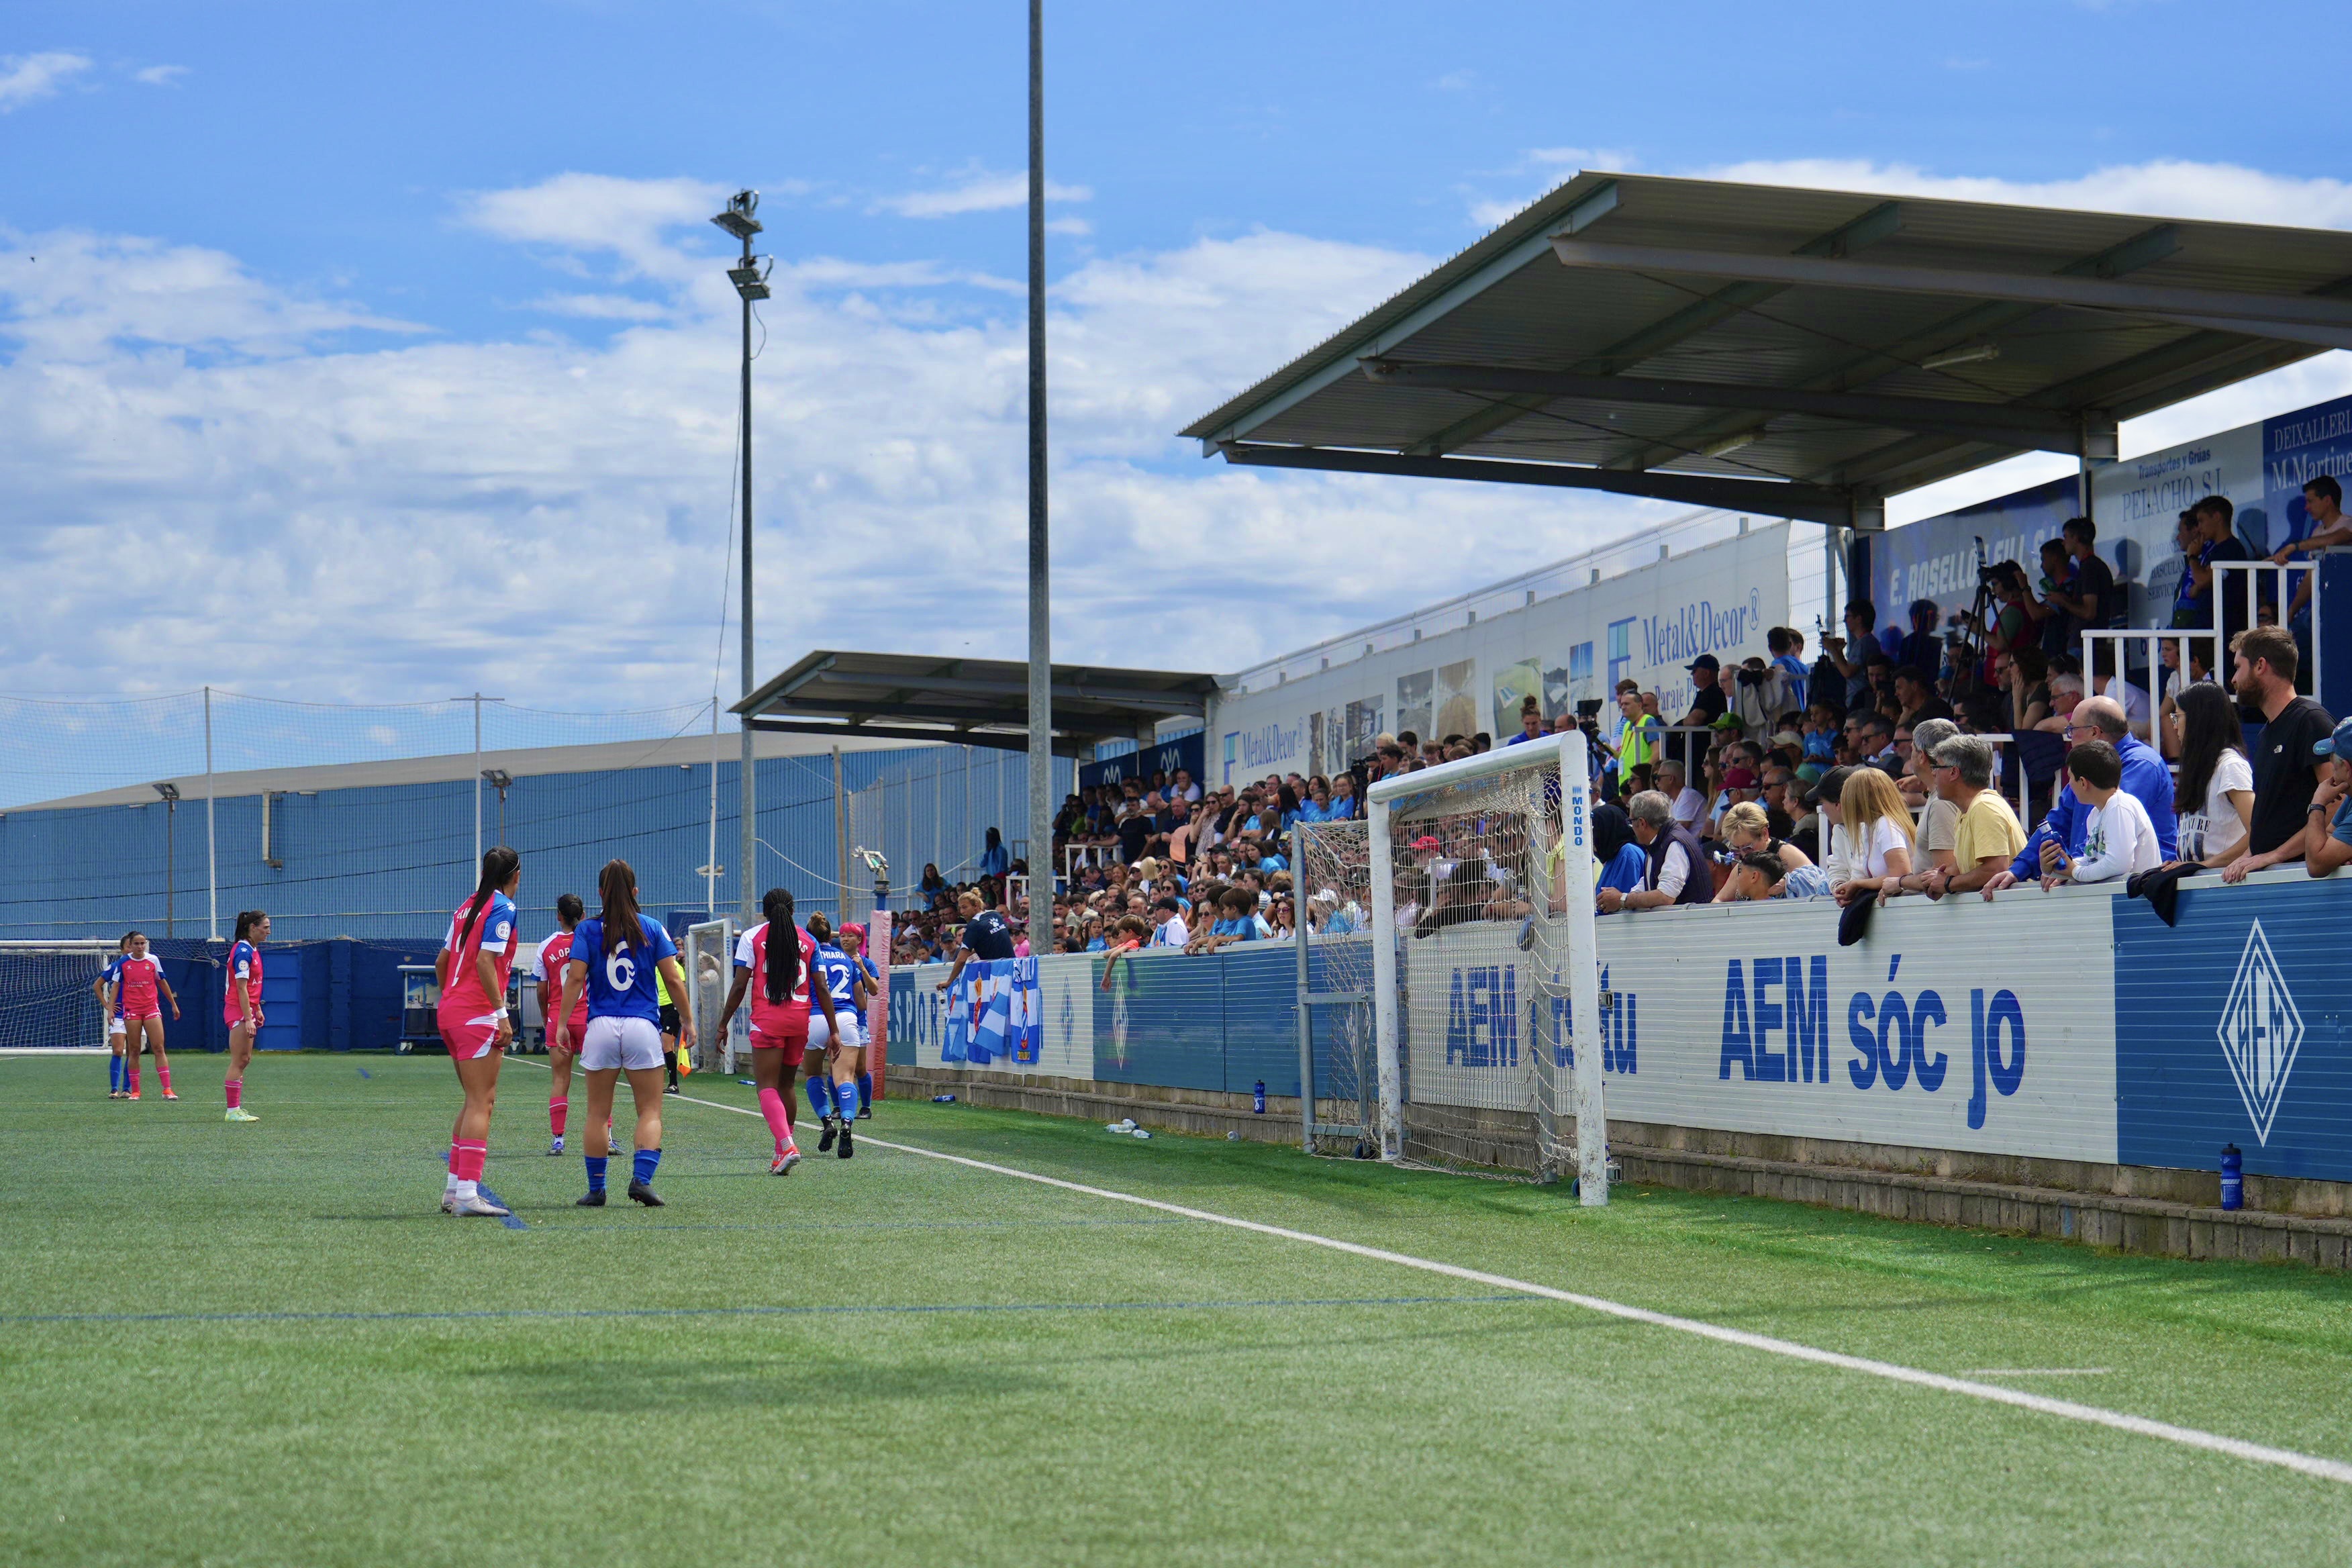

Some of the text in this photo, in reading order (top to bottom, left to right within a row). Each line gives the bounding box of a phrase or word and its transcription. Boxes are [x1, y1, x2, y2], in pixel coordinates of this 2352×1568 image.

[2274, 409, 2352, 453] DEIXALLERI
[2139, 447, 2211, 481] Transportes y Grúas
[1890, 569, 1902, 605] E.
[1572, 797, 1583, 846] MONDO
[989, 924, 1006, 934] KELME
[548, 947, 570, 963] N.OP
[607, 940, 635, 991] 6
[1446, 964, 1517, 1067] AEM
[1718, 955, 1830, 1083] AEM
[1847, 954, 1948, 1092] sóc
